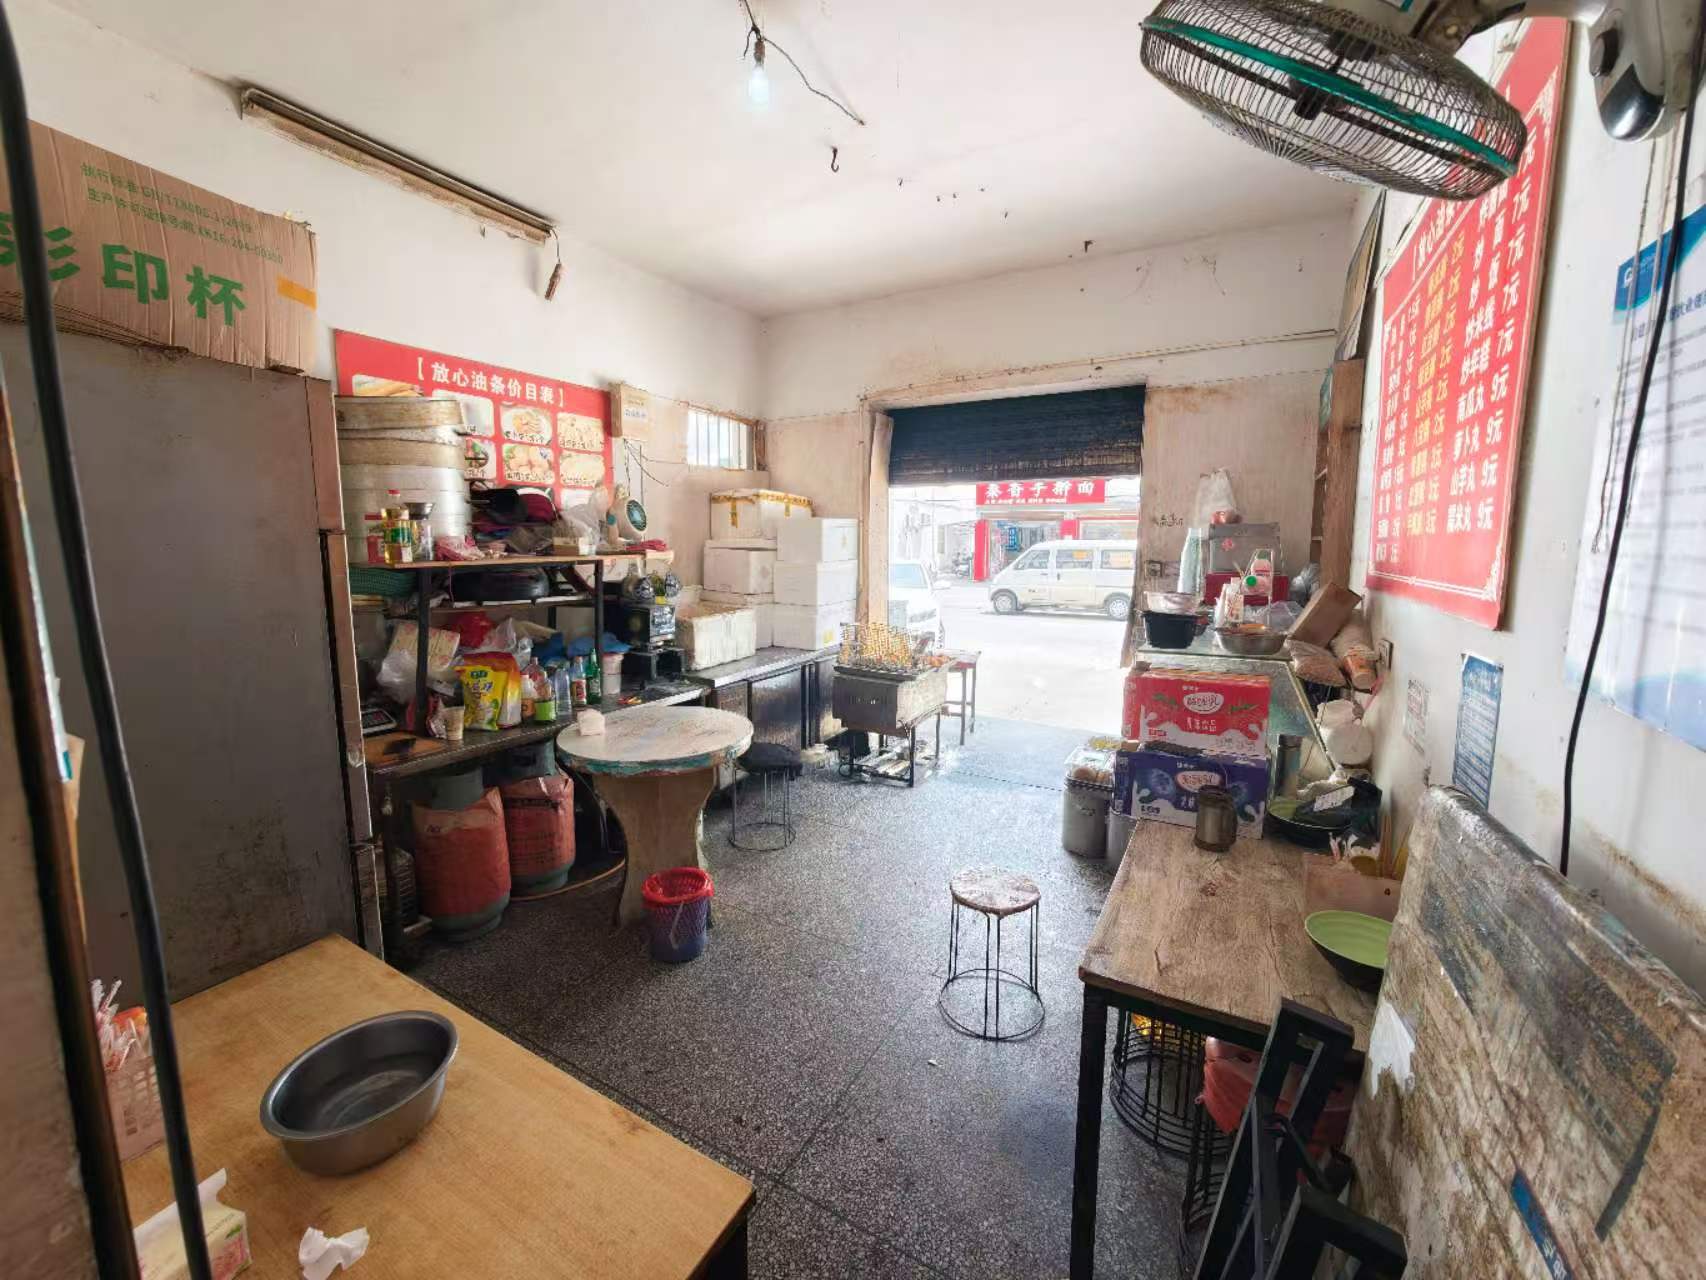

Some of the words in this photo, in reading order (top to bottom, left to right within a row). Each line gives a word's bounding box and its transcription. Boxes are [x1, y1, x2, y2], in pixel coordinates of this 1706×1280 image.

[1513, 176, 1532, 223] 7元
[1507, 224, 1526, 268] 7元
[1502, 272, 1520, 314] 7元
[1497, 320, 1515, 358] 7元
[1490, 363, 1510, 404] 9元
[1485, 409, 1504, 446] 9元
[1481, 454, 1499, 488] 9元
[1477, 496, 1494, 531] 9元
